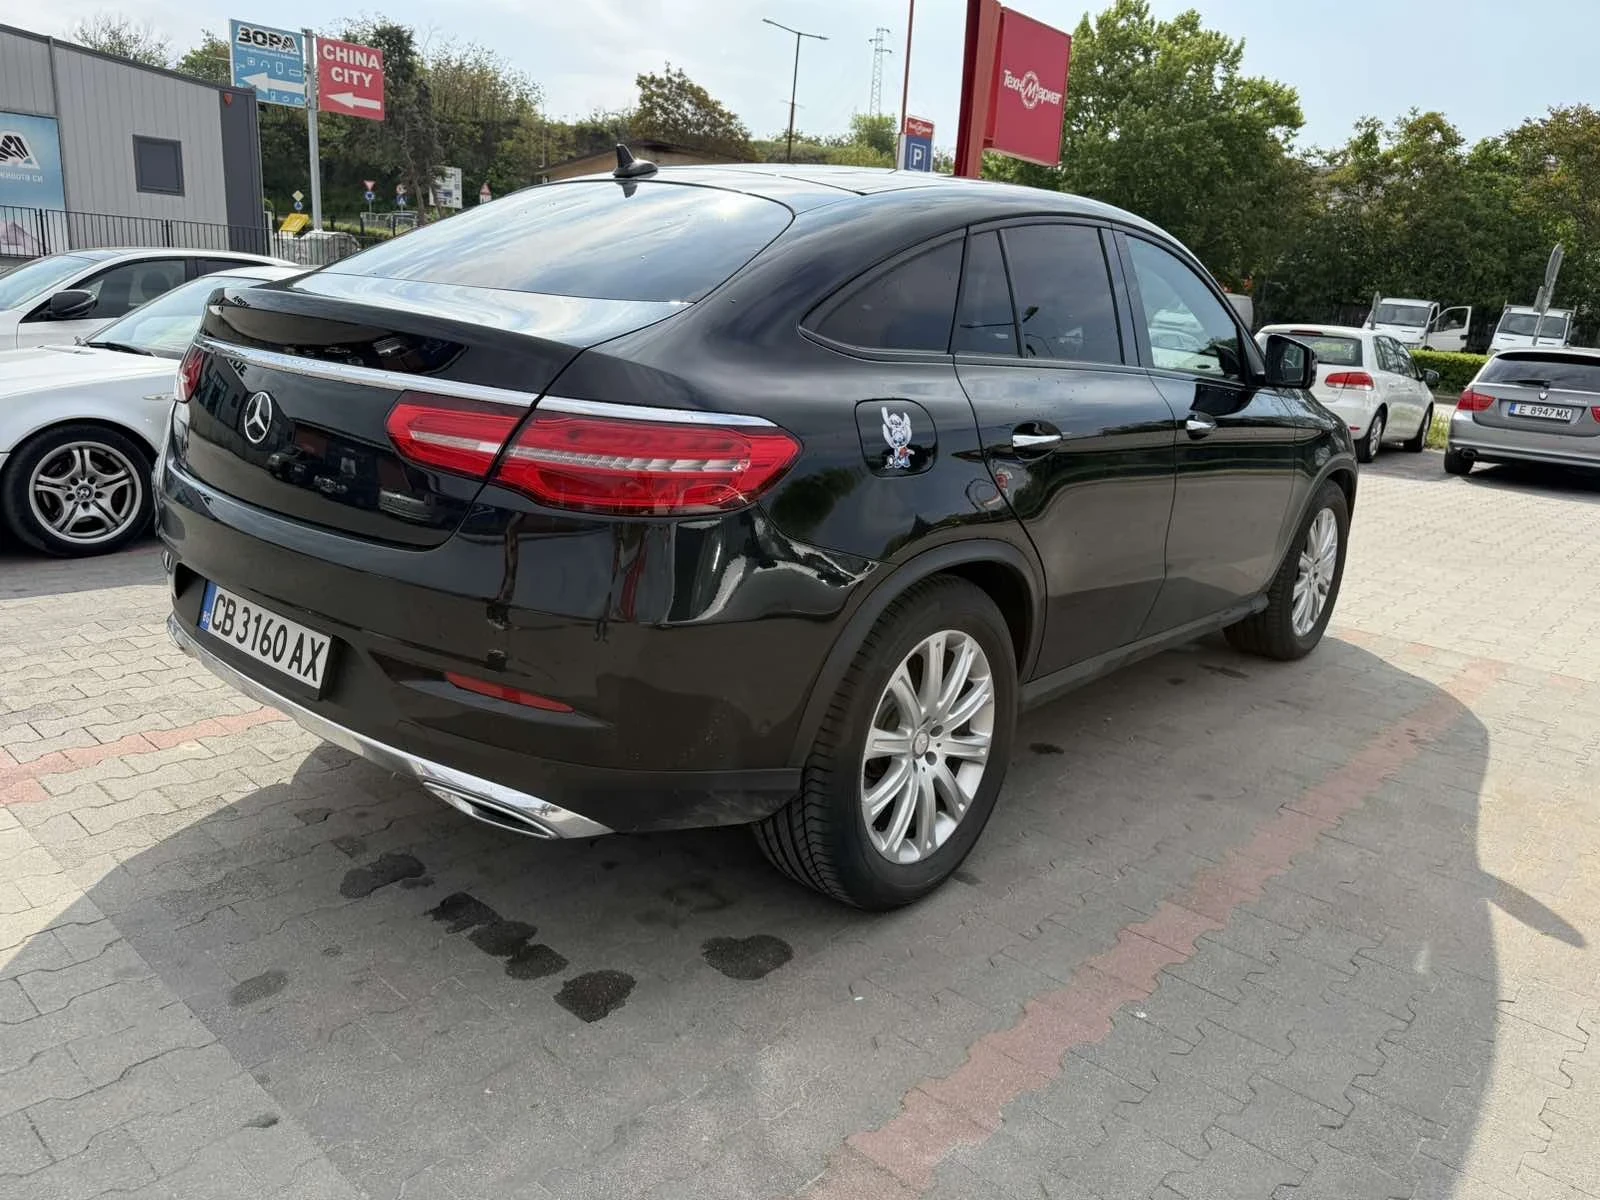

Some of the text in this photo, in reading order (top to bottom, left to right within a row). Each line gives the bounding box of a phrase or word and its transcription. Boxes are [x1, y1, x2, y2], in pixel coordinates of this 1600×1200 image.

[237, 25, 299, 54] ЗОРА
[322, 44, 380, 70] CHINA
[331, 66, 373, 88] CITY
[912, 148, 922, 167] P
[1519, 405, 1570, 419] E 8947 MX
[211, 593, 326, 682] CB 3160 AX
